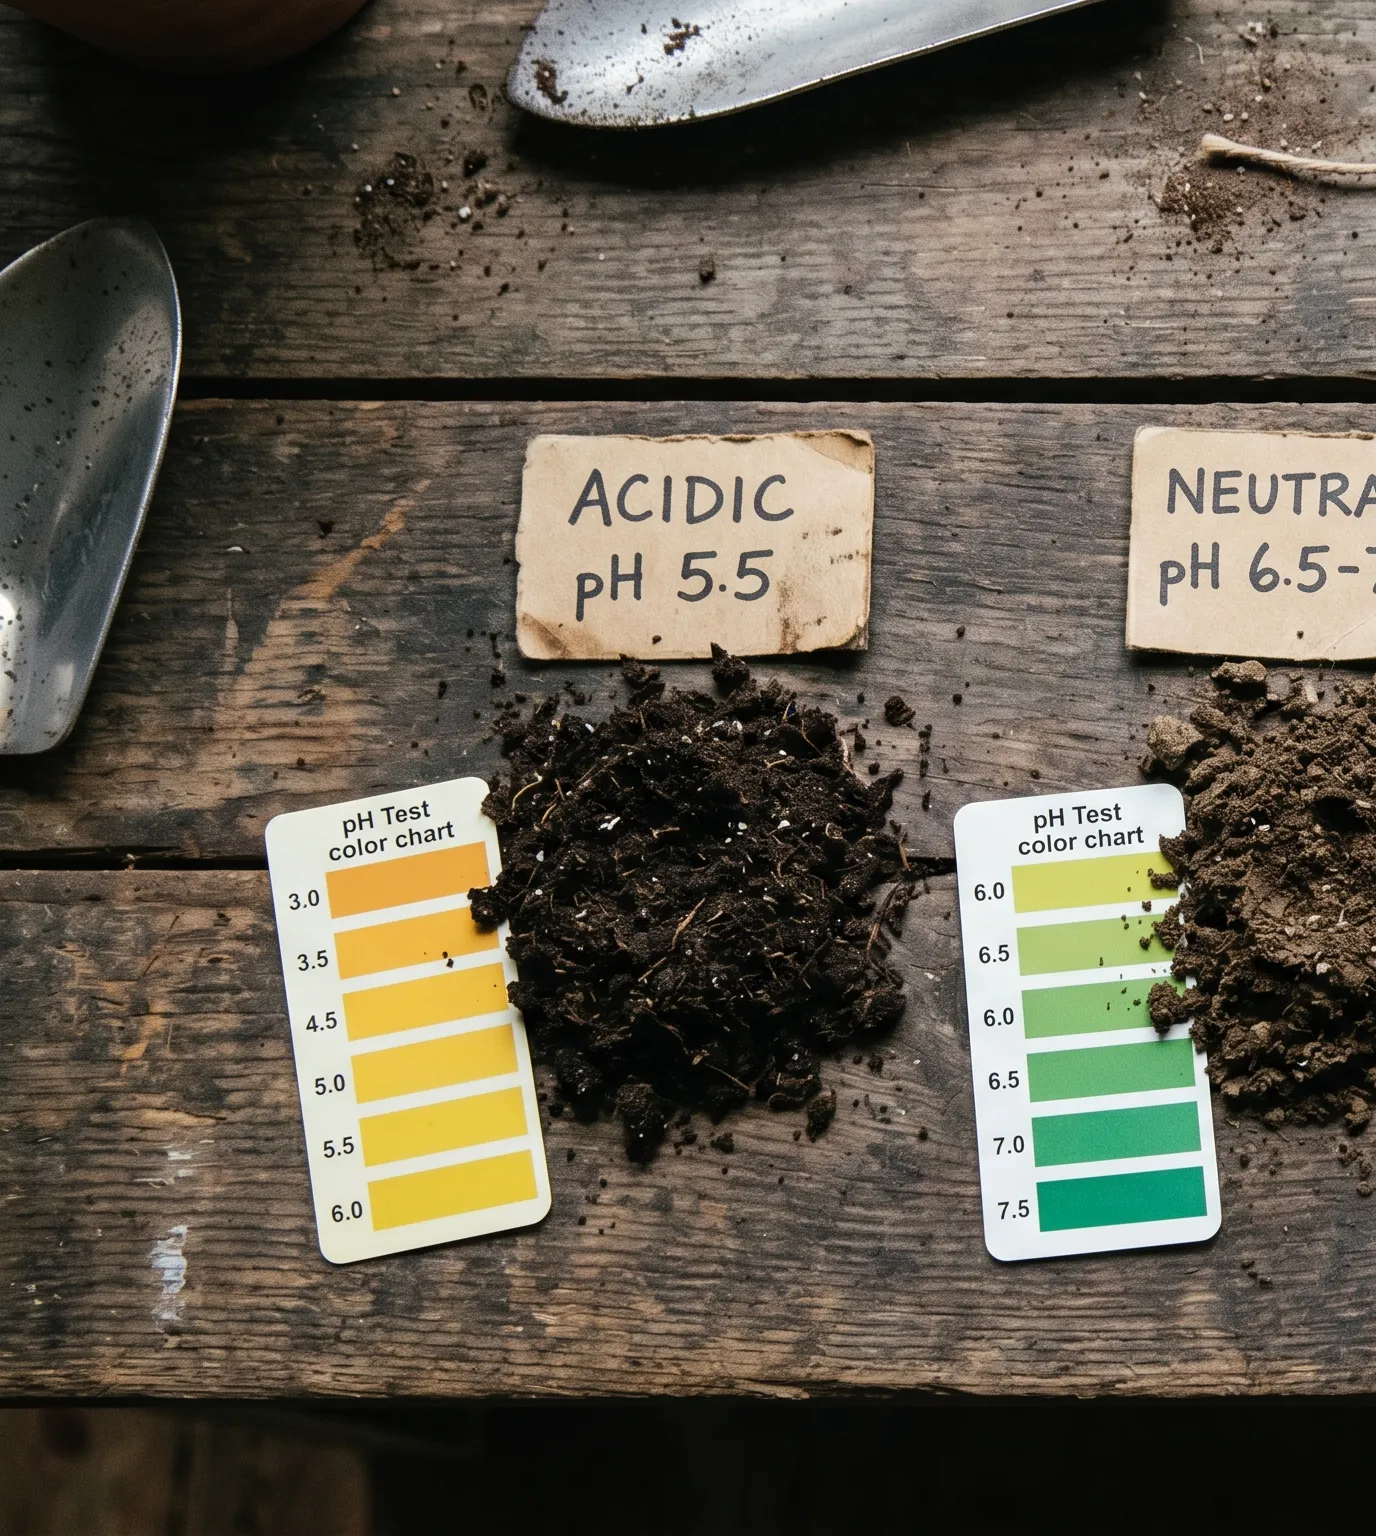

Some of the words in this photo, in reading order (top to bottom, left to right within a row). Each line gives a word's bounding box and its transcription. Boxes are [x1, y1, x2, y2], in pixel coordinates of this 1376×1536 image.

[568, 469, 794, 527] ACIDIC
[1160, 542, 1219, 606] pH
[576, 553, 642, 622] pH
[677, 549, 773, 602] 5.5
[343, 811, 374, 838] pH
[381, 801, 430, 824] Test
[1034, 808, 1065, 833] pH
[1072, 804, 1121, 824] Test
[329, 837, 388, 861] color
[396, 821, 455, 848] chart
[1019, 835, 1078, 855] color
[1085, 826, 1144, 848] chart
[289, 890, 319, 910] 3.0
[975, 882, 1004, 901] 6.0
[298, 950, 328, 971] 3.5
[979, 945, 1009, 963] 6.5
[306, 1012, 337, 1032] 4.5
[984, 1008, 1014, 1026] 6.0
[315, 1074, 345, 1095] 5.0
[989, 1071, 1019, 1090] 6.5
[324, 1137, 354, 1158] 5.5
[994, 1136, 1024, 1155] 7.0
[332, 1201, 362, 1222] 6.0
[998, 1200, 1029, 1219] 7.5
